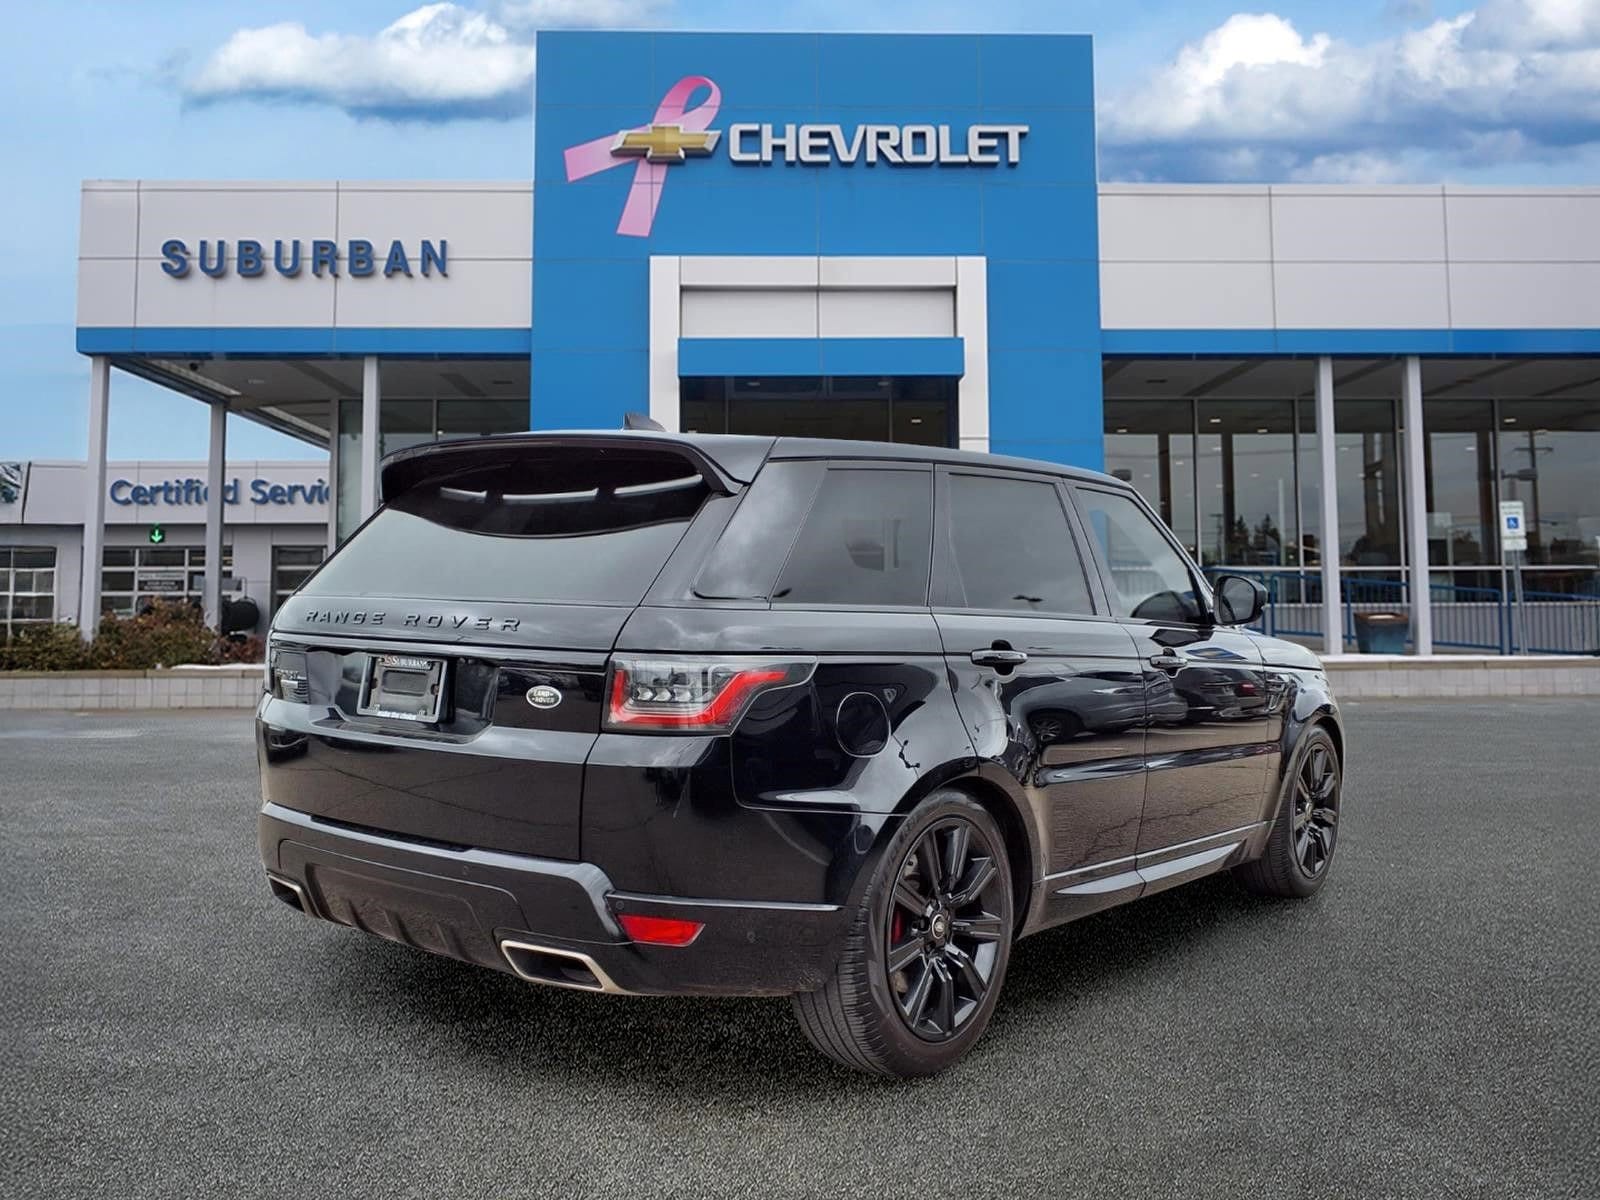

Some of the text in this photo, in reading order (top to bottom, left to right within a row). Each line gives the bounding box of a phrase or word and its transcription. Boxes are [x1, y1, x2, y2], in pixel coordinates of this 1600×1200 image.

[729, 123, 1029, 164] CHEVROLET
[161, 240, 449, 278] SUBURBAN
[305, 610, 521, 632] RANGE ROVER
